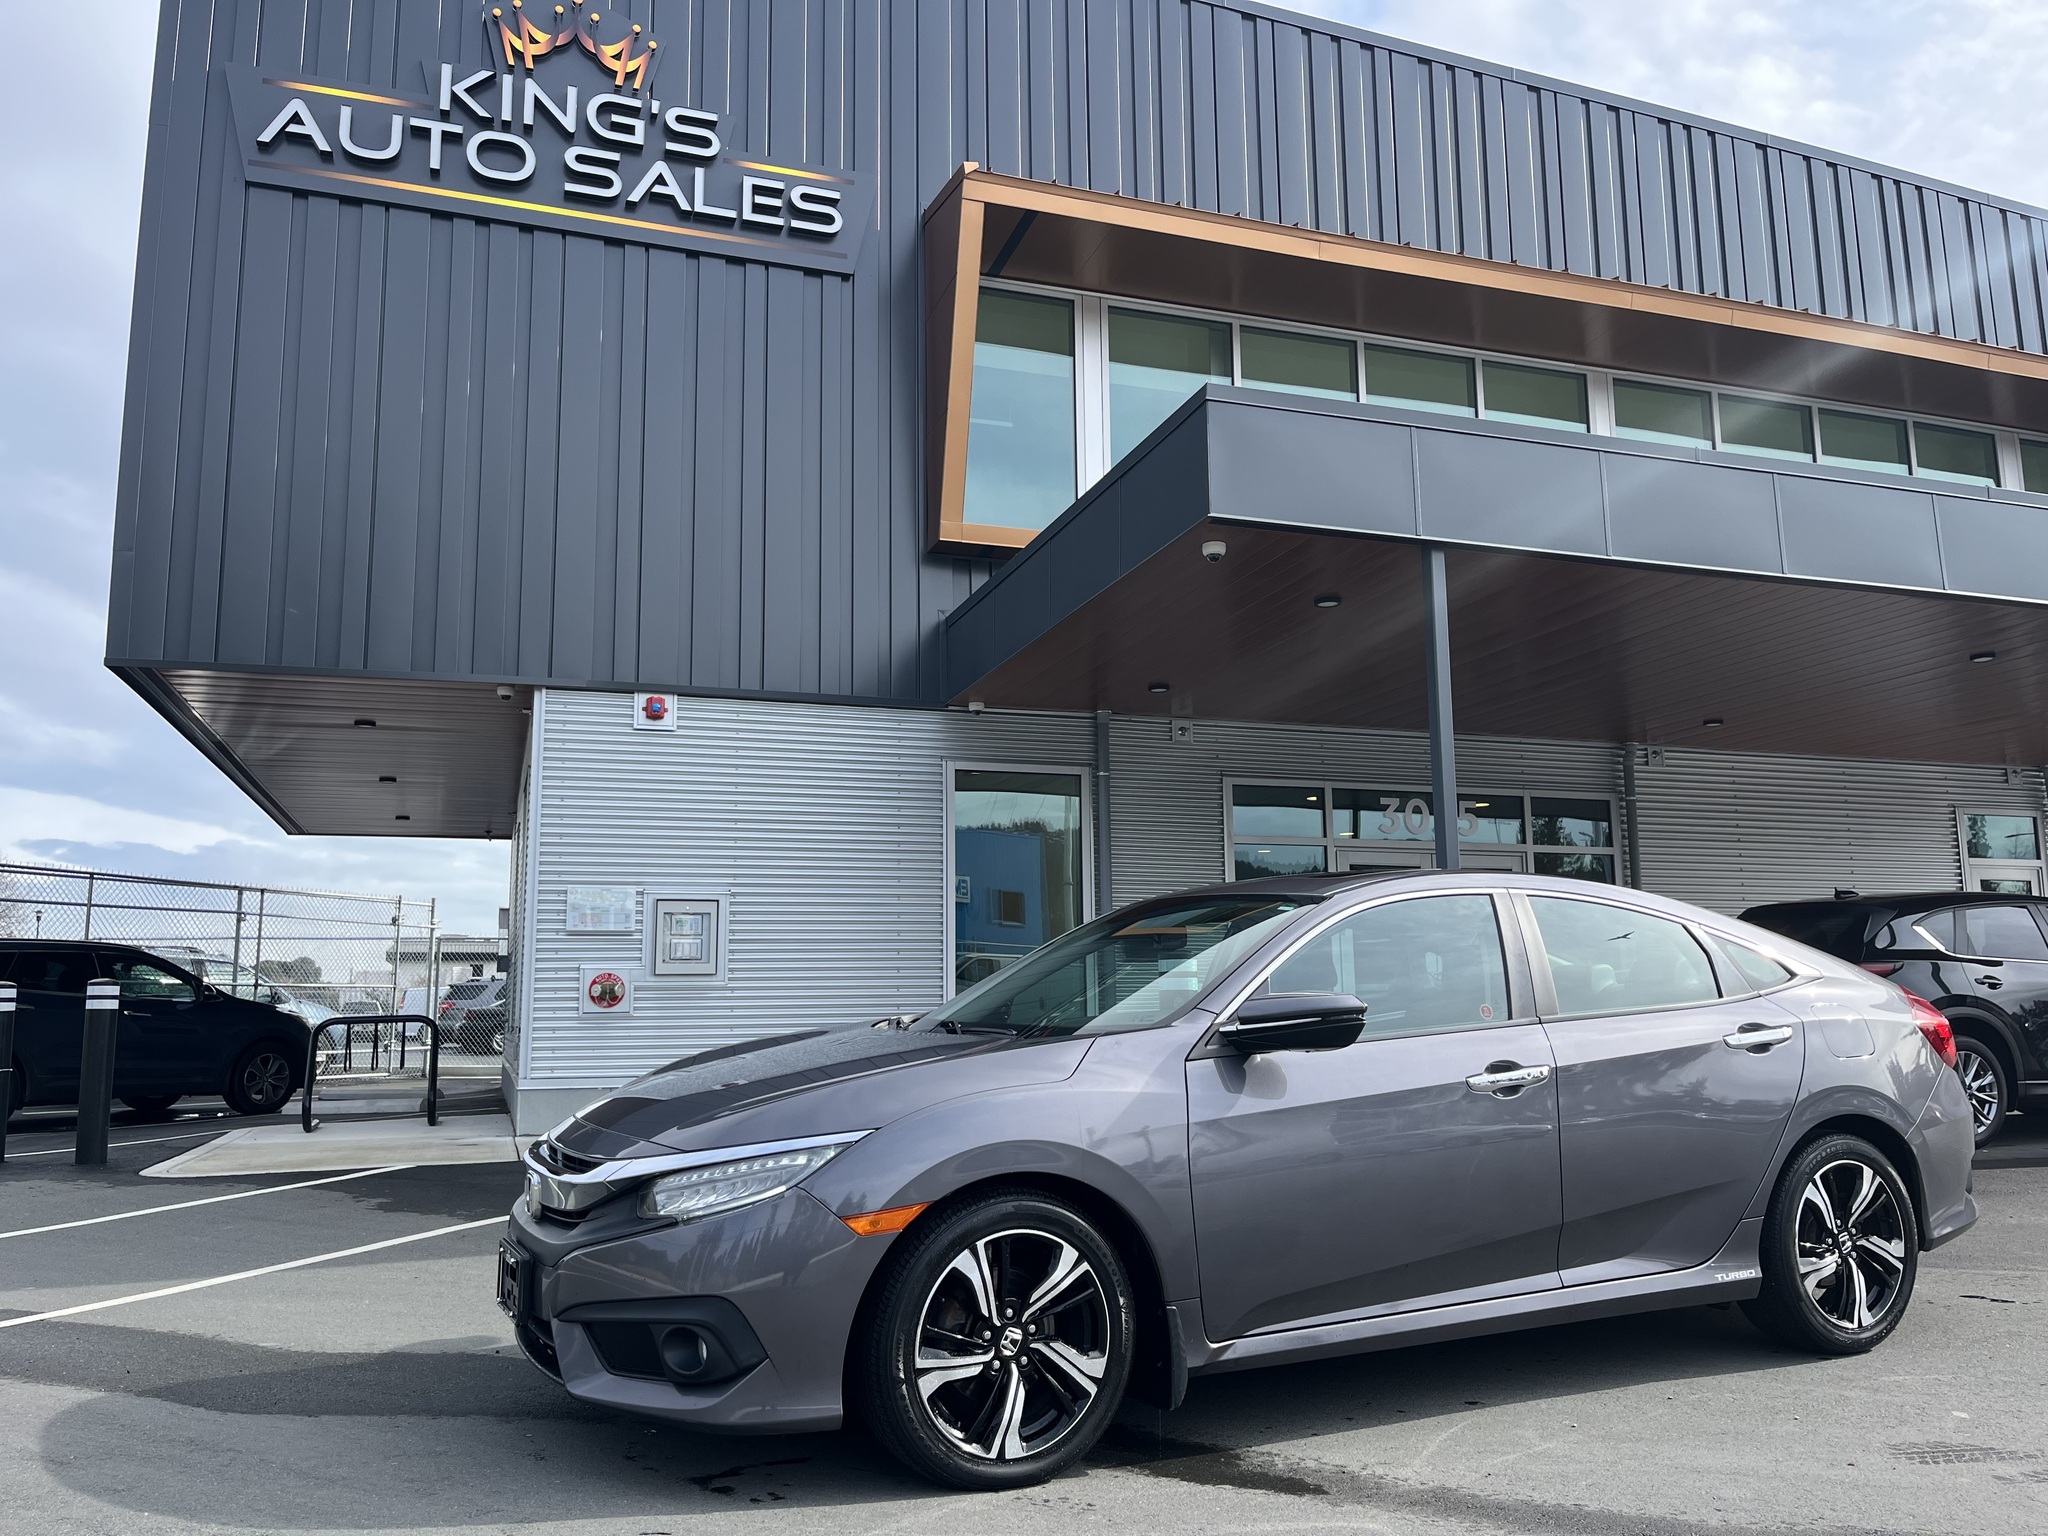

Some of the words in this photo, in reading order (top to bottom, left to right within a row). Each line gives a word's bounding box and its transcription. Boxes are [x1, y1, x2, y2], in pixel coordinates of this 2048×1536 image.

[439, 62, 722, 158] KING'S
[256, 97, 537, 185] AUTO
[563, 144, 844, 236] SALES
[1377, 796, 1479, 837] 305
[595, 973, 609, 982] AUTO
[1714, 1269, 1756, 1281] TURBO
